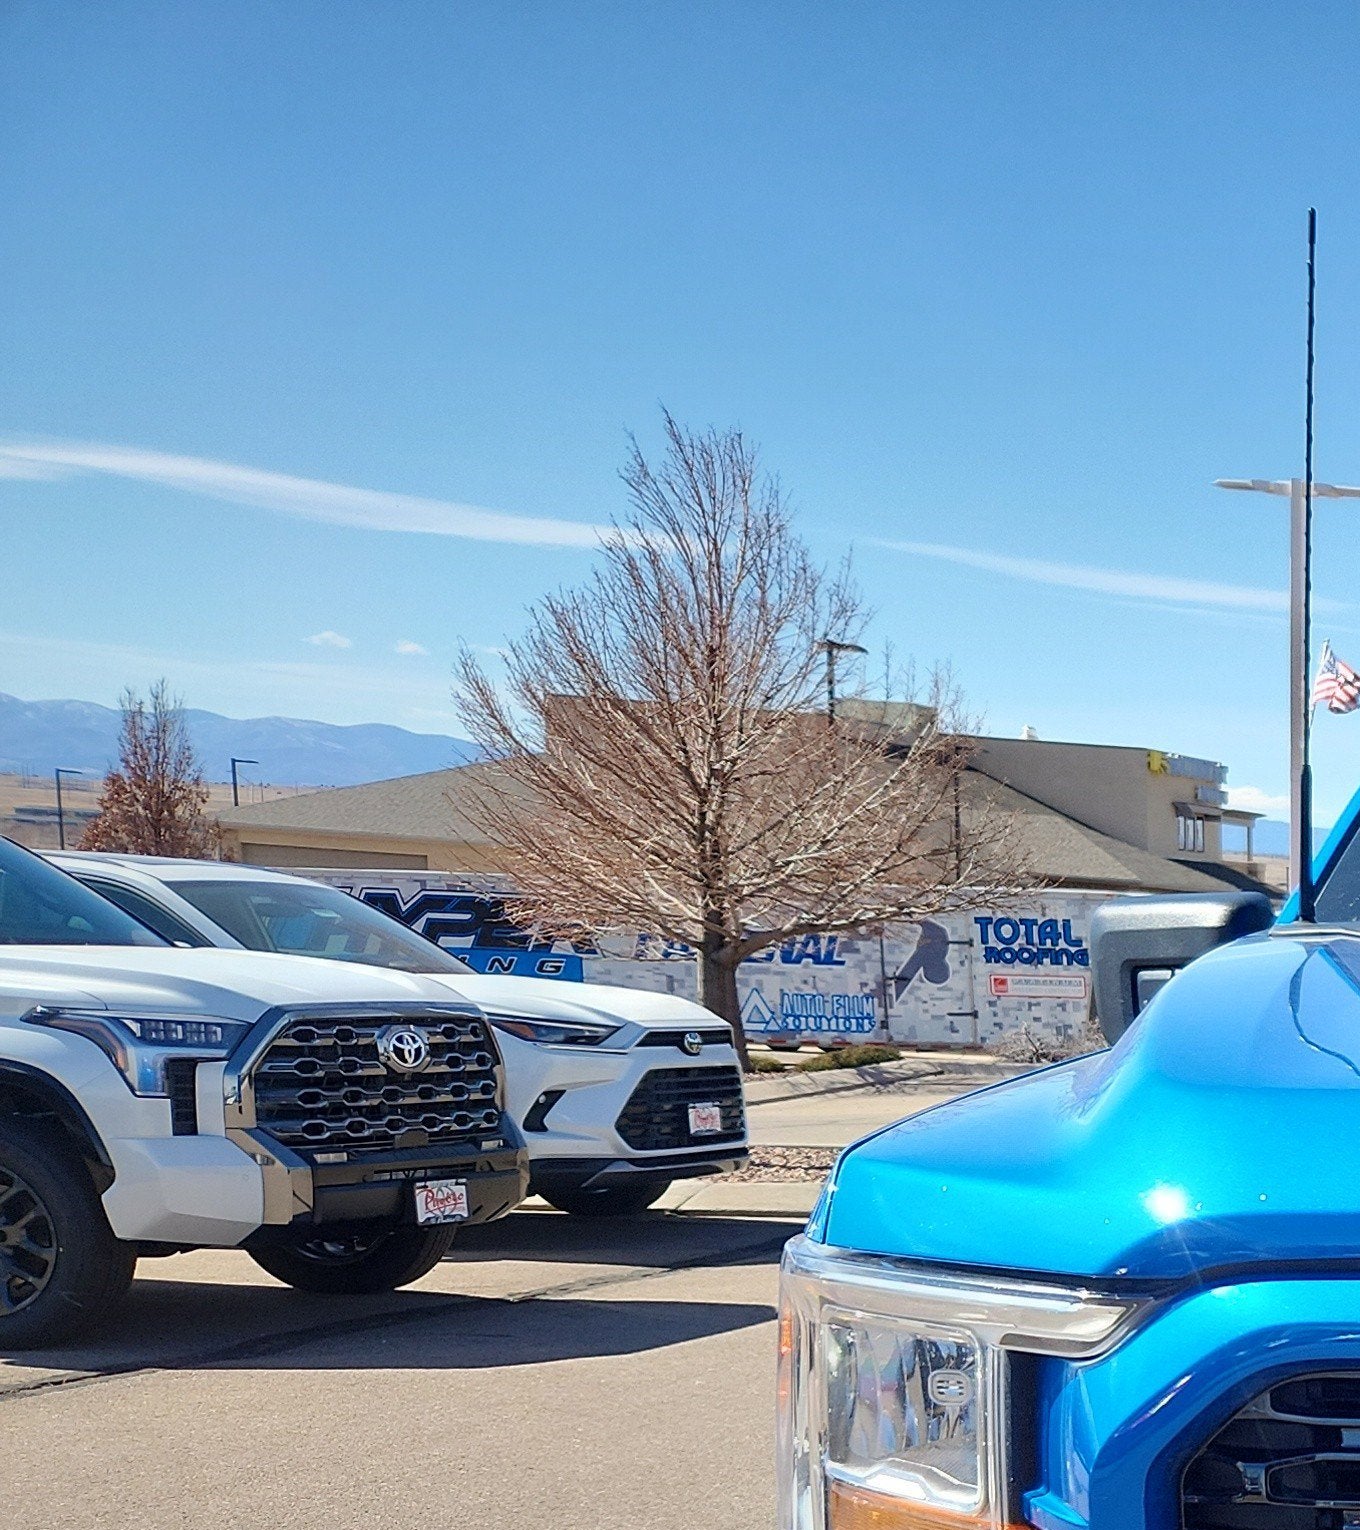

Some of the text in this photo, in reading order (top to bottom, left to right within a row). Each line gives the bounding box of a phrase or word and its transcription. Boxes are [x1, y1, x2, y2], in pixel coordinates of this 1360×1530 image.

[974, 916, 1083, 947] TOTAL
[781, 992, 875, 1018] AUTO FILM
